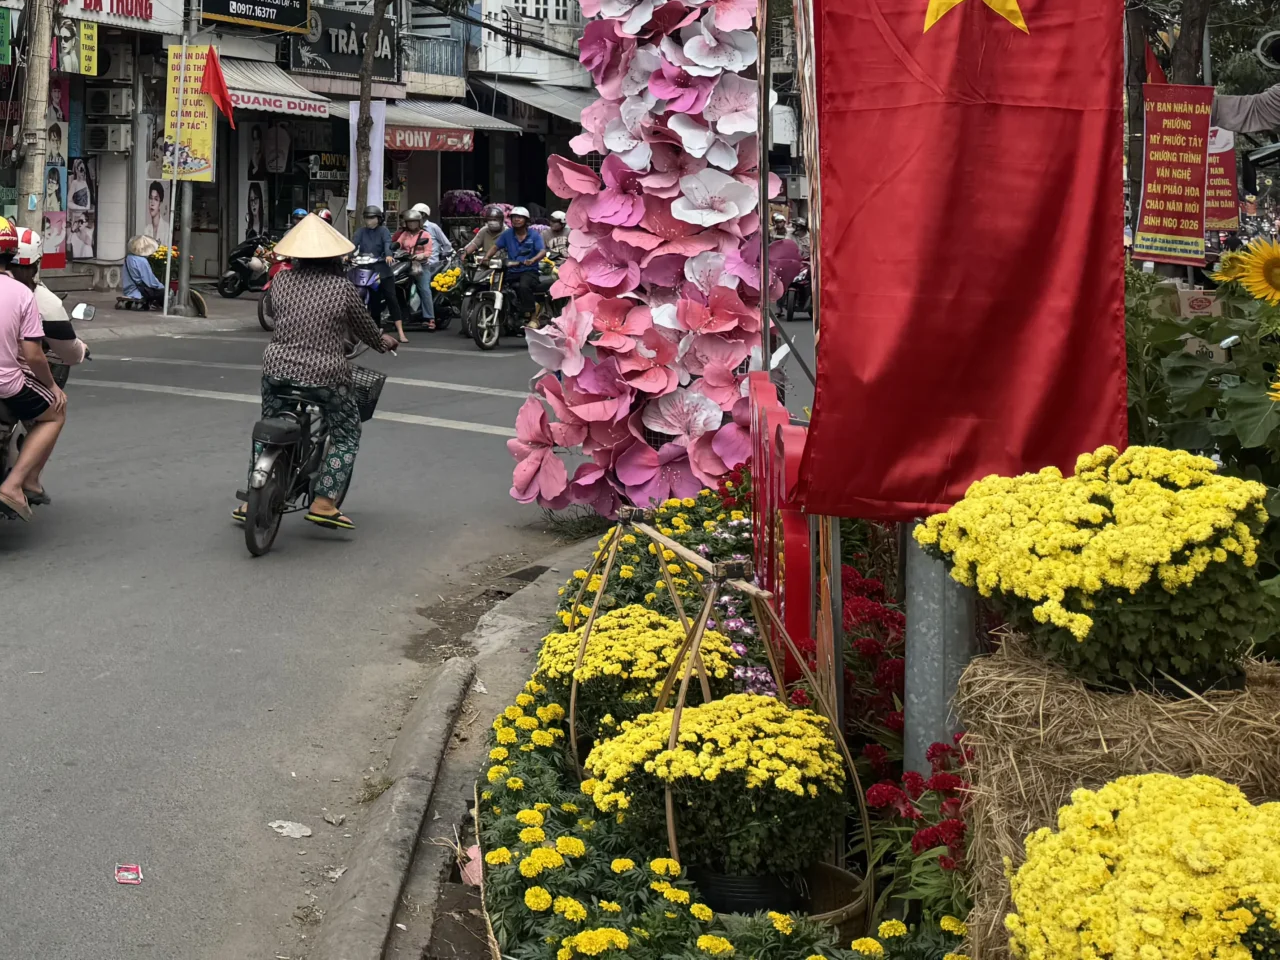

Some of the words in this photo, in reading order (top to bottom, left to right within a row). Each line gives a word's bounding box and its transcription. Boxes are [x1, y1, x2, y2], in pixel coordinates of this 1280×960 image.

[236, 2, 277, 20] 0917.163717
[328, 21, 358, 56] TRÀ
[230, 93, 282, 108] QUANG
[287, 100, 327, 114] DŨNG
[1157, 102, 1172, 113] BAN
[1173, 101, 1193, 114] NHÂN
[1195, 102, 1211, 115] DÂN
[1162, 117, 1191, 130] PHƯỜNG
[396, 130, 431, 148] PONY
[1150, 133, 1161, 145] MỸ
[1162, 134, 1186, 146] PHƯỚC
[1188, 135, 1203, 148] TÂY
[1149, 150, 1177, 162] CHƯƠNG
[1179, 150, 1201, 164] TRÌNH
[1184, 187, 1200, 197] HOA
[1145, 196, 1164, 210] CHÀO
[1179, 219, 1199, 230] 2026
